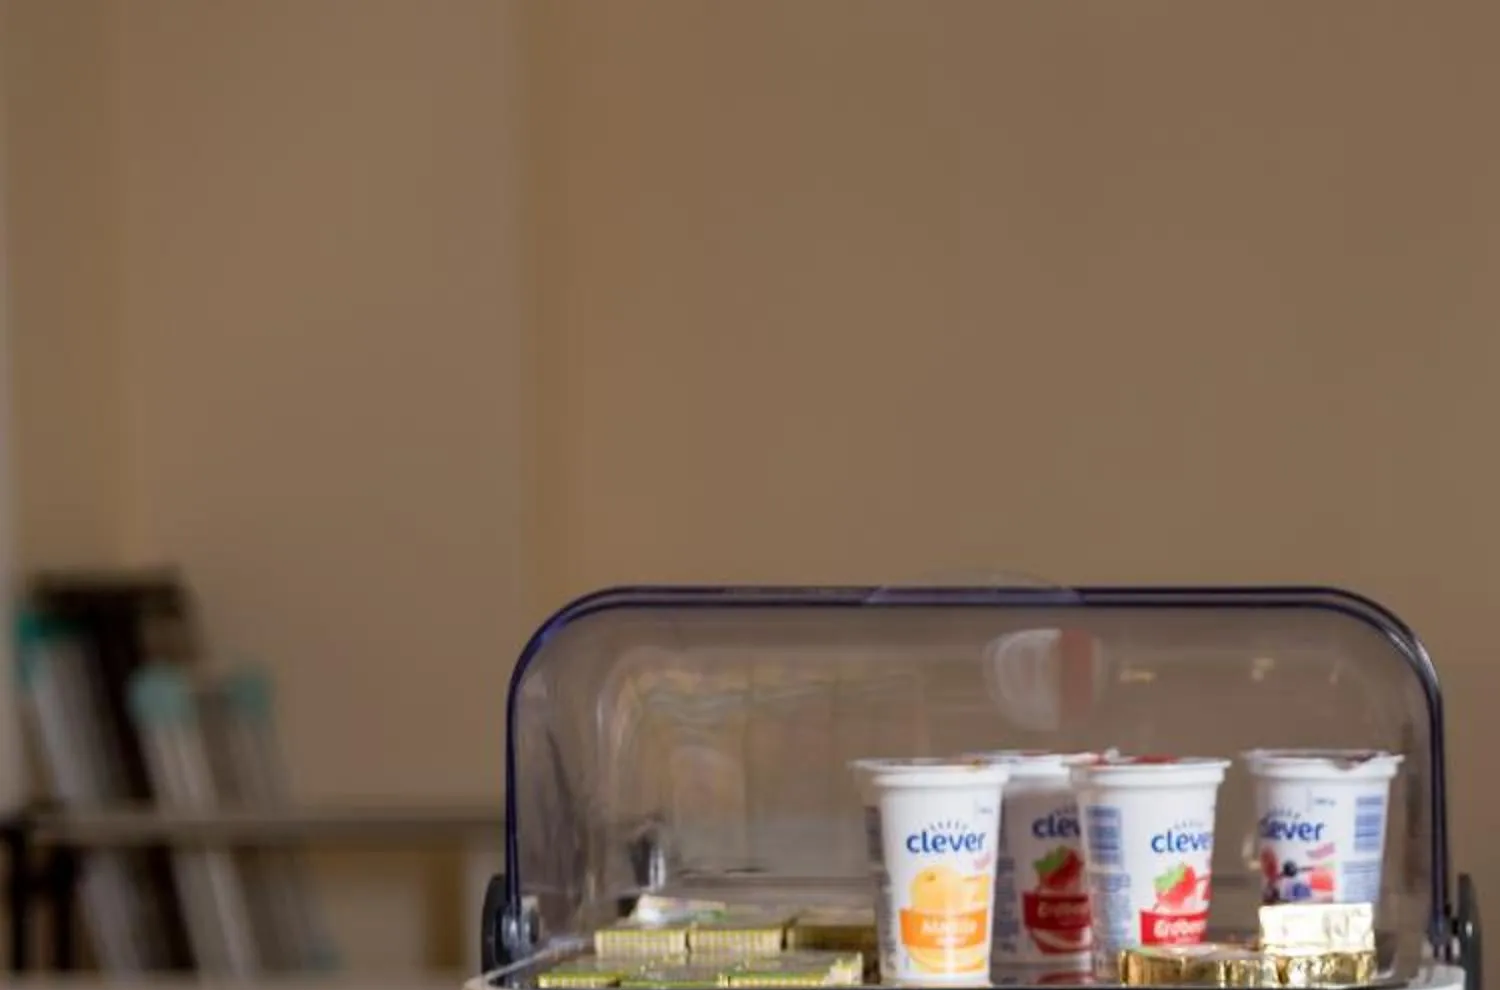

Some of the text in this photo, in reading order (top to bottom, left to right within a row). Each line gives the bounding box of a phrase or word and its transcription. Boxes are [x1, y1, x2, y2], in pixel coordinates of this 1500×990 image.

[1032, 812, 1080, 838] clev
[906, 830, 986, 853] clever
[1151, 829, 1212, 853] cleve
